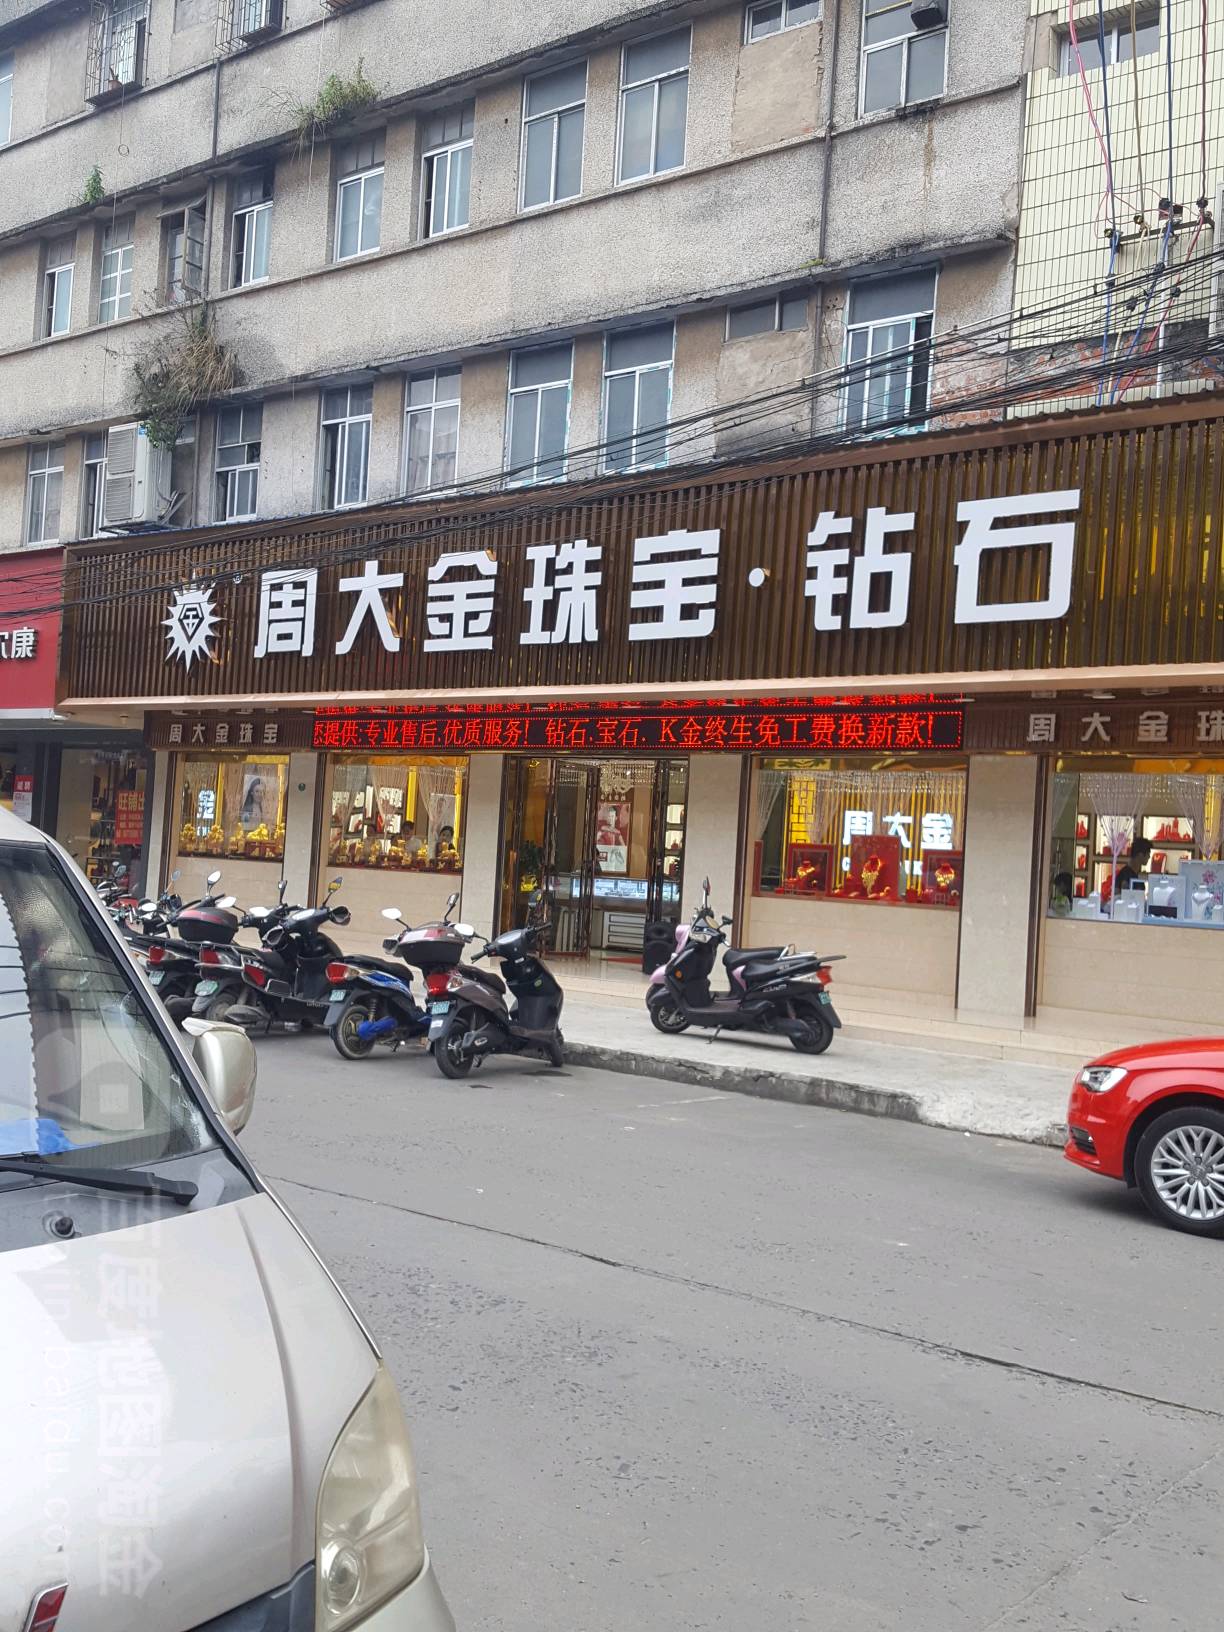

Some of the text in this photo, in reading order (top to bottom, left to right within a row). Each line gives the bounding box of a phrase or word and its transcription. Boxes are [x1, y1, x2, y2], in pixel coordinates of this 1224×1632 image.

[169, 723, 279, 744] 周大金珠宝
